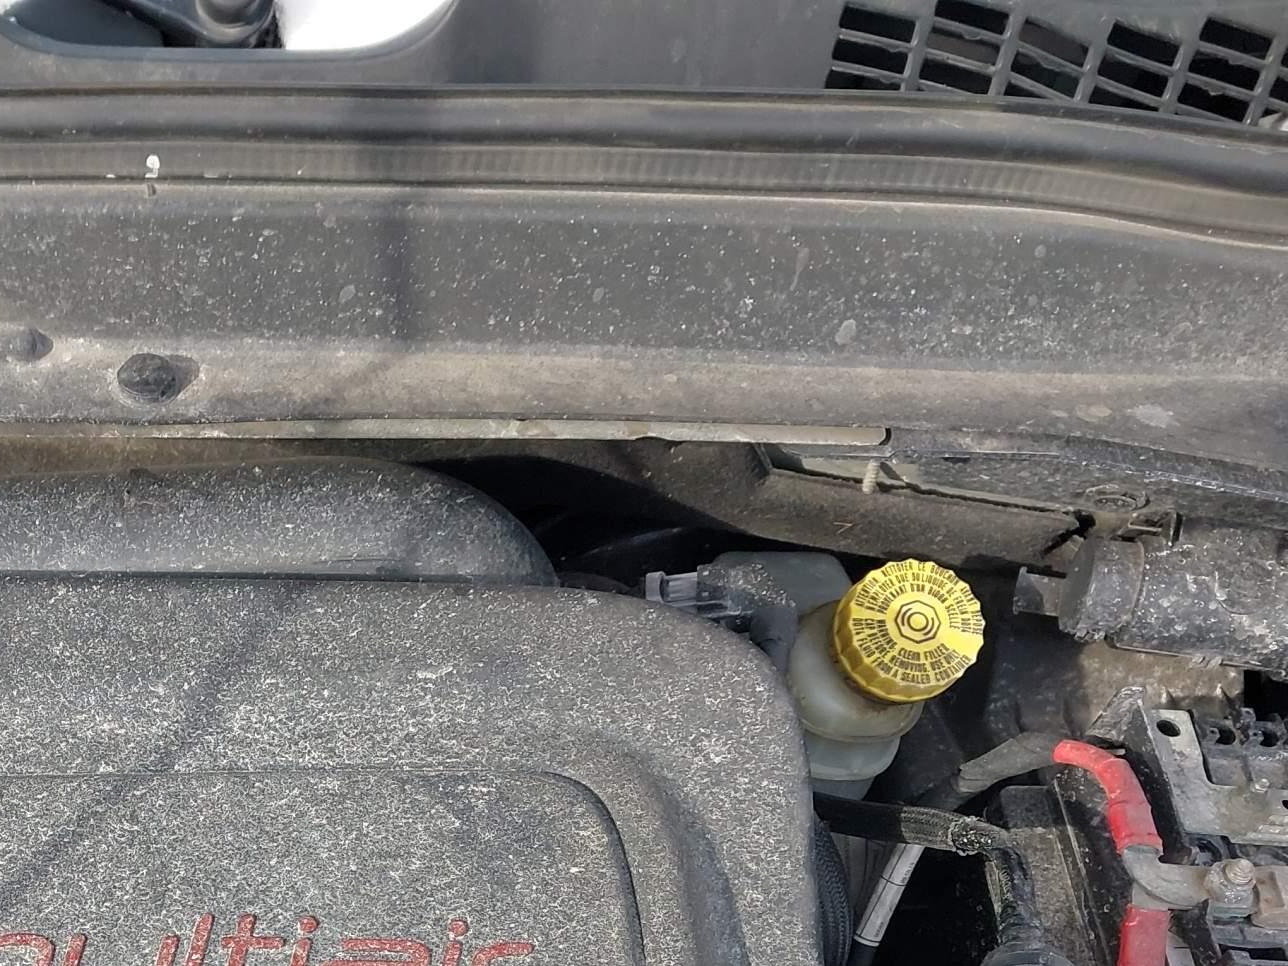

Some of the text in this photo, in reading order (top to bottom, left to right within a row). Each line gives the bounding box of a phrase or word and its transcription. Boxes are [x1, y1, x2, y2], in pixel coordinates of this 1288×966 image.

[864, 618, 876, 631] CAP
[866, 632, 891, 659] BEFORE
[898, 647, 921, 662] CLEAN
[923, 642, 951, 661] FILLER
[856, 637, 876, 658] FLUID
[871, 656, 893, 676] FROM
[890, 668, 900, 679] A
[899, 671, 931, 685] SEALED
[934, 654, 973, 683] CONTAINER
[929, 658, 946, 671] USE
[943, 648, 961, 665] ONLY
